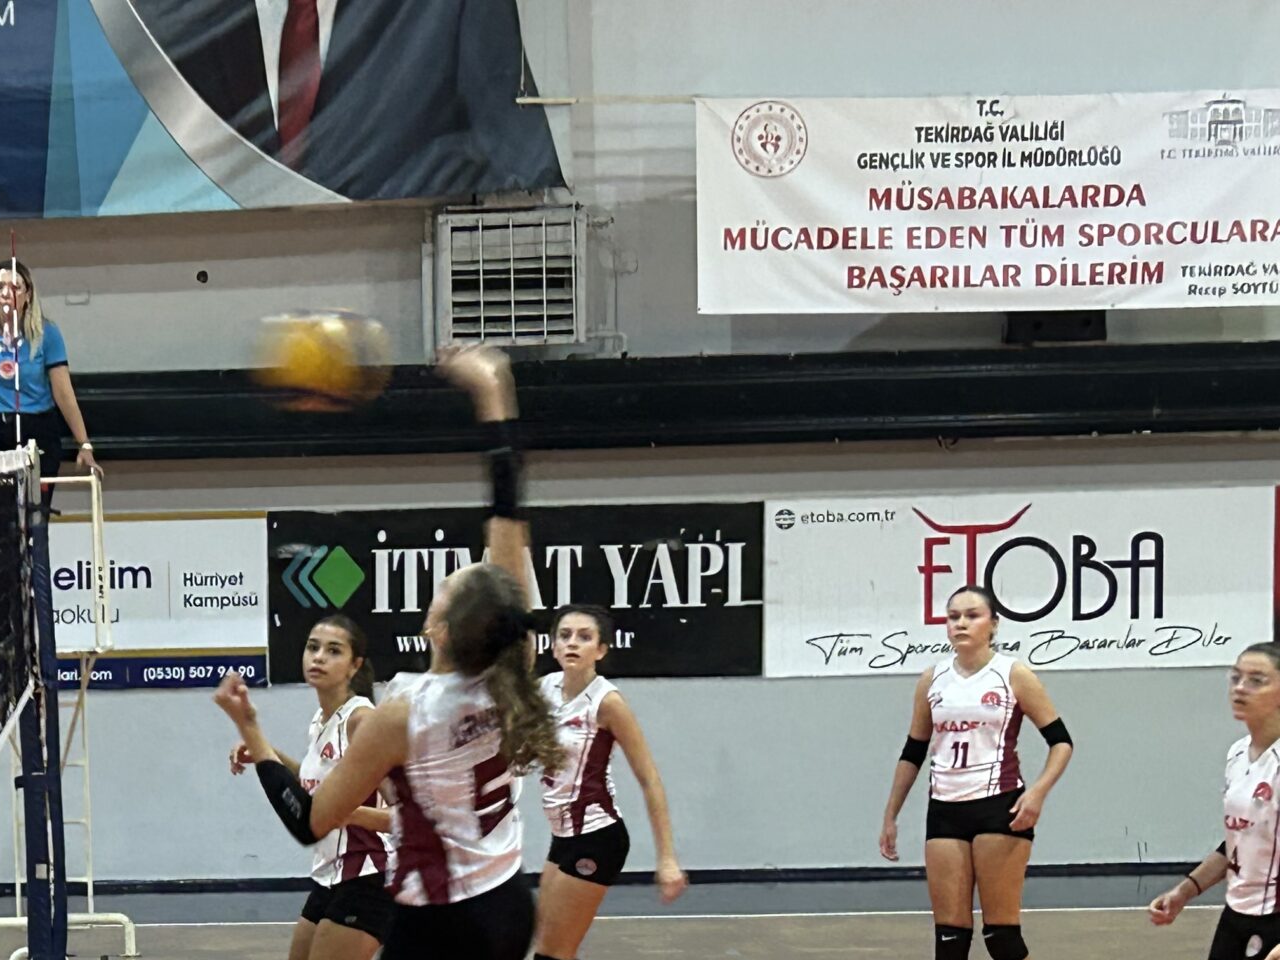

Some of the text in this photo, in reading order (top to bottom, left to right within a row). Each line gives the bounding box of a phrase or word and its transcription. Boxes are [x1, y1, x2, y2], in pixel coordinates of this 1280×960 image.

[915, 120, 1065, 143] TEKİRDAĞ VALİLİĞİ
[857, 148, 925, 172] GENÇLİK
[929, 152, 951, 168] VE
[955, 152, 998, 168] SPOR
[1020, 145, 1121, 168] MÜDÜRLÜĞÜ
[868, 180, 1147, 211] MÜSABAKALARDA
[723, 219, 894, 251] MÜCADELE
[906, 225, 987, 249] EDEN
[1000, 217, 1065, 248] TÜM
[846, 254, 1164, 296] BAŞARILAR DİLERİM
[53, 559, 152, 591] eliim
[911, 503, 1165, 626] ETOBA
[183, 572, 244, 589] Hürriyet
[183, 591, 259, 610] Kampüsü
[143, 666, 185, 683] (0530)
[189, 665, 214, 679] 507
[238, 665, 255, 678] 90
[951, 741, 969, 769] 11
